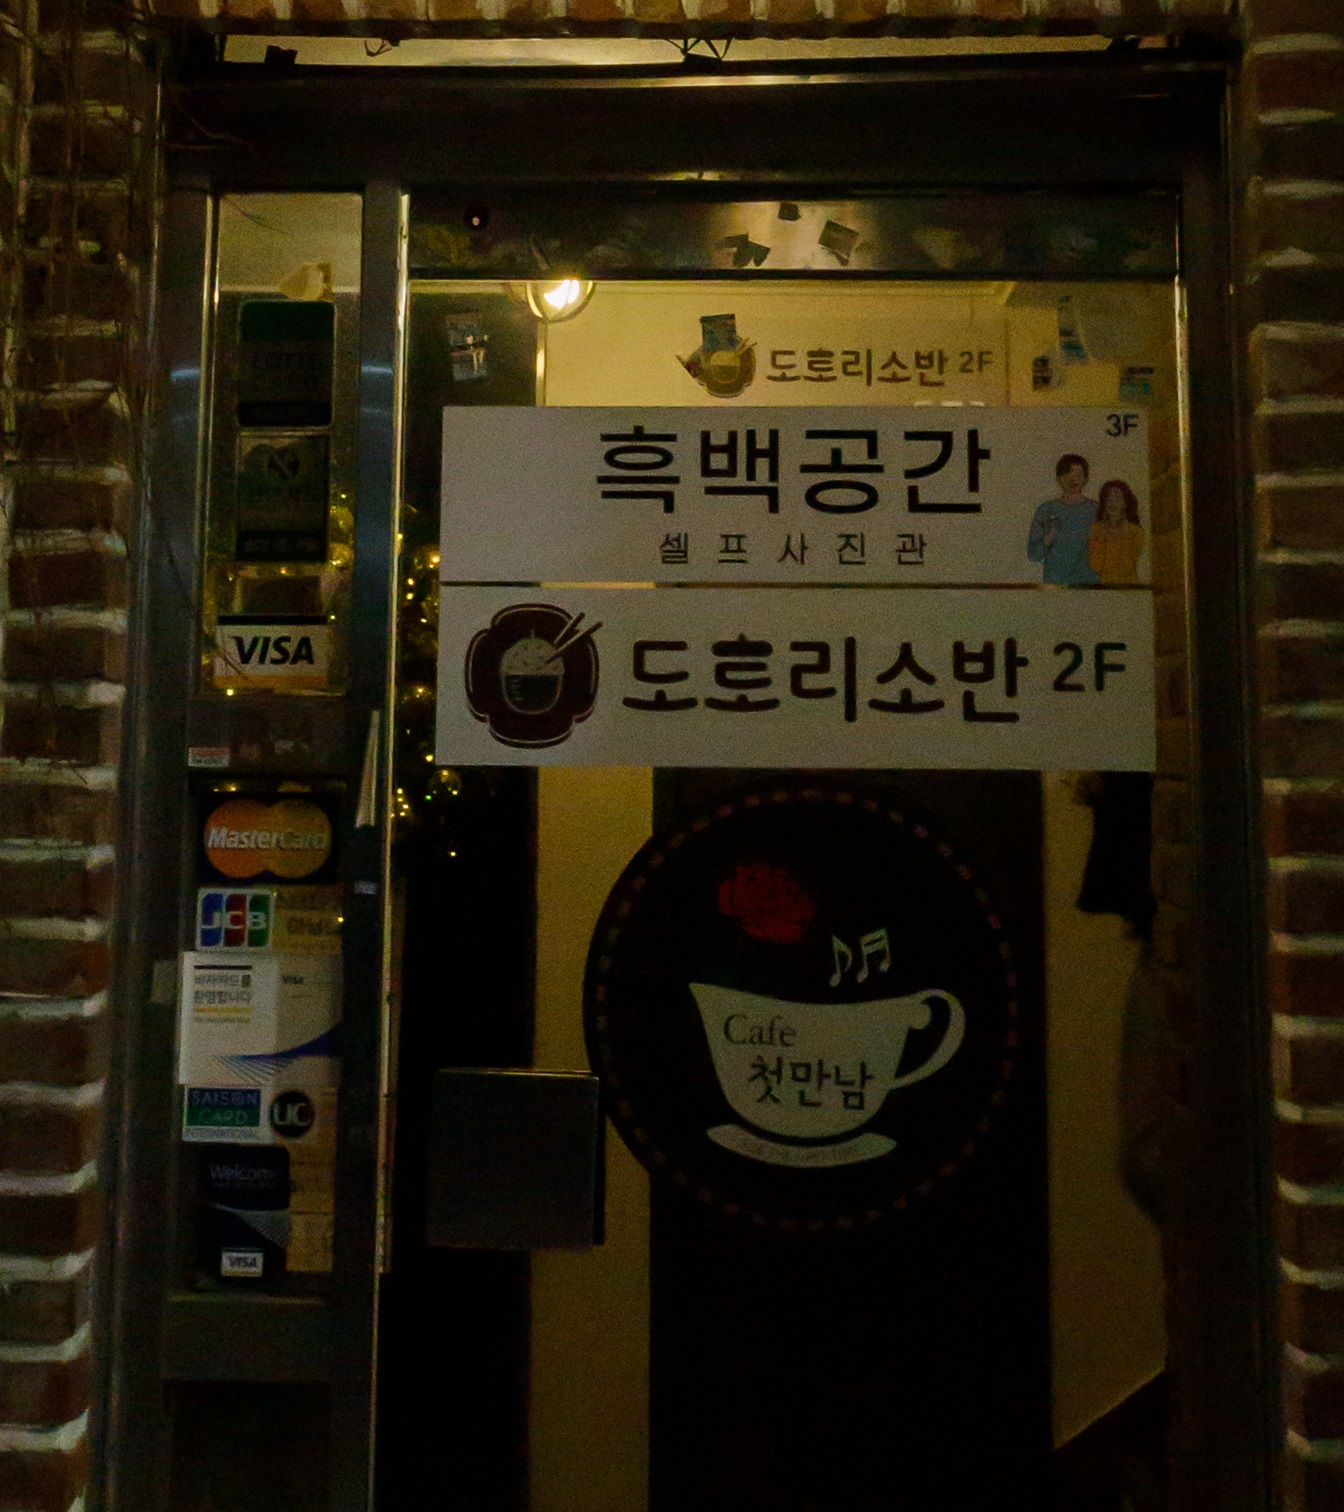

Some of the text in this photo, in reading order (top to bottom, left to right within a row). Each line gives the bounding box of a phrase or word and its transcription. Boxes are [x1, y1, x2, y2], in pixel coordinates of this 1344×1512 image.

[766, 347, 994, 388] 도토리소반 2F
[1106, 413, 1139, 437] 3F
[596, 425, 991, 515] 흑백공간
[229, 635, 315, 665] VISA
[622, 633, 1127, 723] 도토리소반 2F
[207, 827, 327, 850] MasterCard
[201, 911, 268, 930] JCB
[723, 1012, 797, 1048] Cafe
[190, 1089, 257, 1106] SAISON
[747, 1054, 874, 1111] 첫만남
